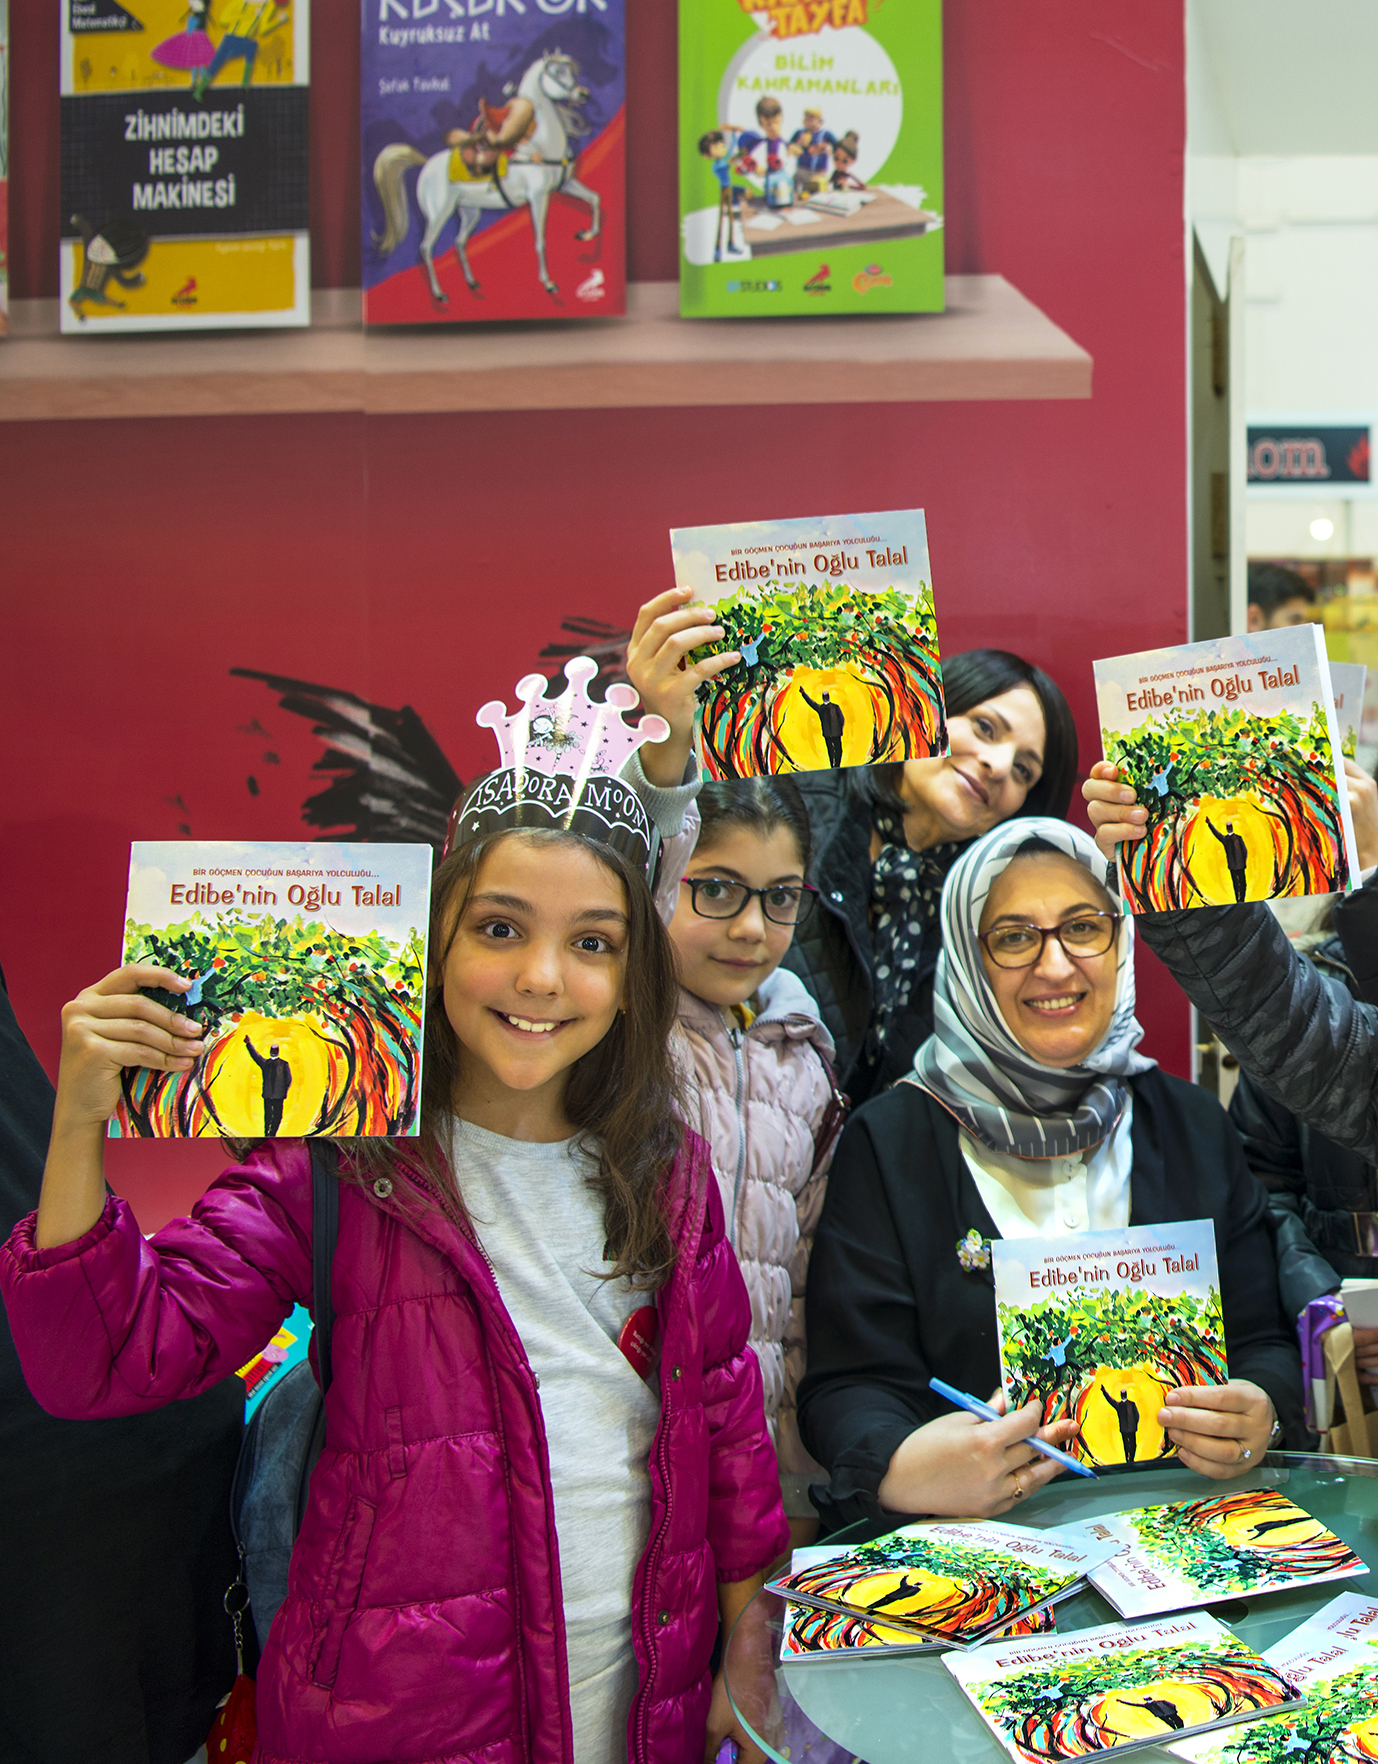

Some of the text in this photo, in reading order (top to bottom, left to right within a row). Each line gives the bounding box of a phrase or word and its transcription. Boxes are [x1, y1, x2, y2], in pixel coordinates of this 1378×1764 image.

[378, 20, 490, 48] Kuyruksuz At
[770, 0, 866, 39] TAYFA
[736, 75, 900, 95] KAHRAMANLARI
[124, 103, 245, 141] ZİHNİMDEKİ
[149, 145, 219, 175] HESAP
[132, 173, 236, 210] MAKİNESİ
[715, 545, 908, 582] Edibe'nin Oğlu Talal
[1126, 664, 1300, 711] Edibe'nin Oğlu Talal
[584, 780, 647, 829] MOON
[169, 882, 402, 912] Edibe'nin Oğlu Talal
[1029, 1253, 1200, 1288] Edibe'nin Oğlu Talal
[929, 1525, 1000, 1545] Edibe'nin
[1005, 1541, 1044, 1555] Oğlu
[1048, 1549, 1088, 1563] Talal
[996, 1647, 1094, 1668] Edibe'nin
[1098, 1633, 1148, 1650] Oğlu
[1150, 1621, 1199, 1638] Talal
[1307, 1645, 1349, 1665] Talal
